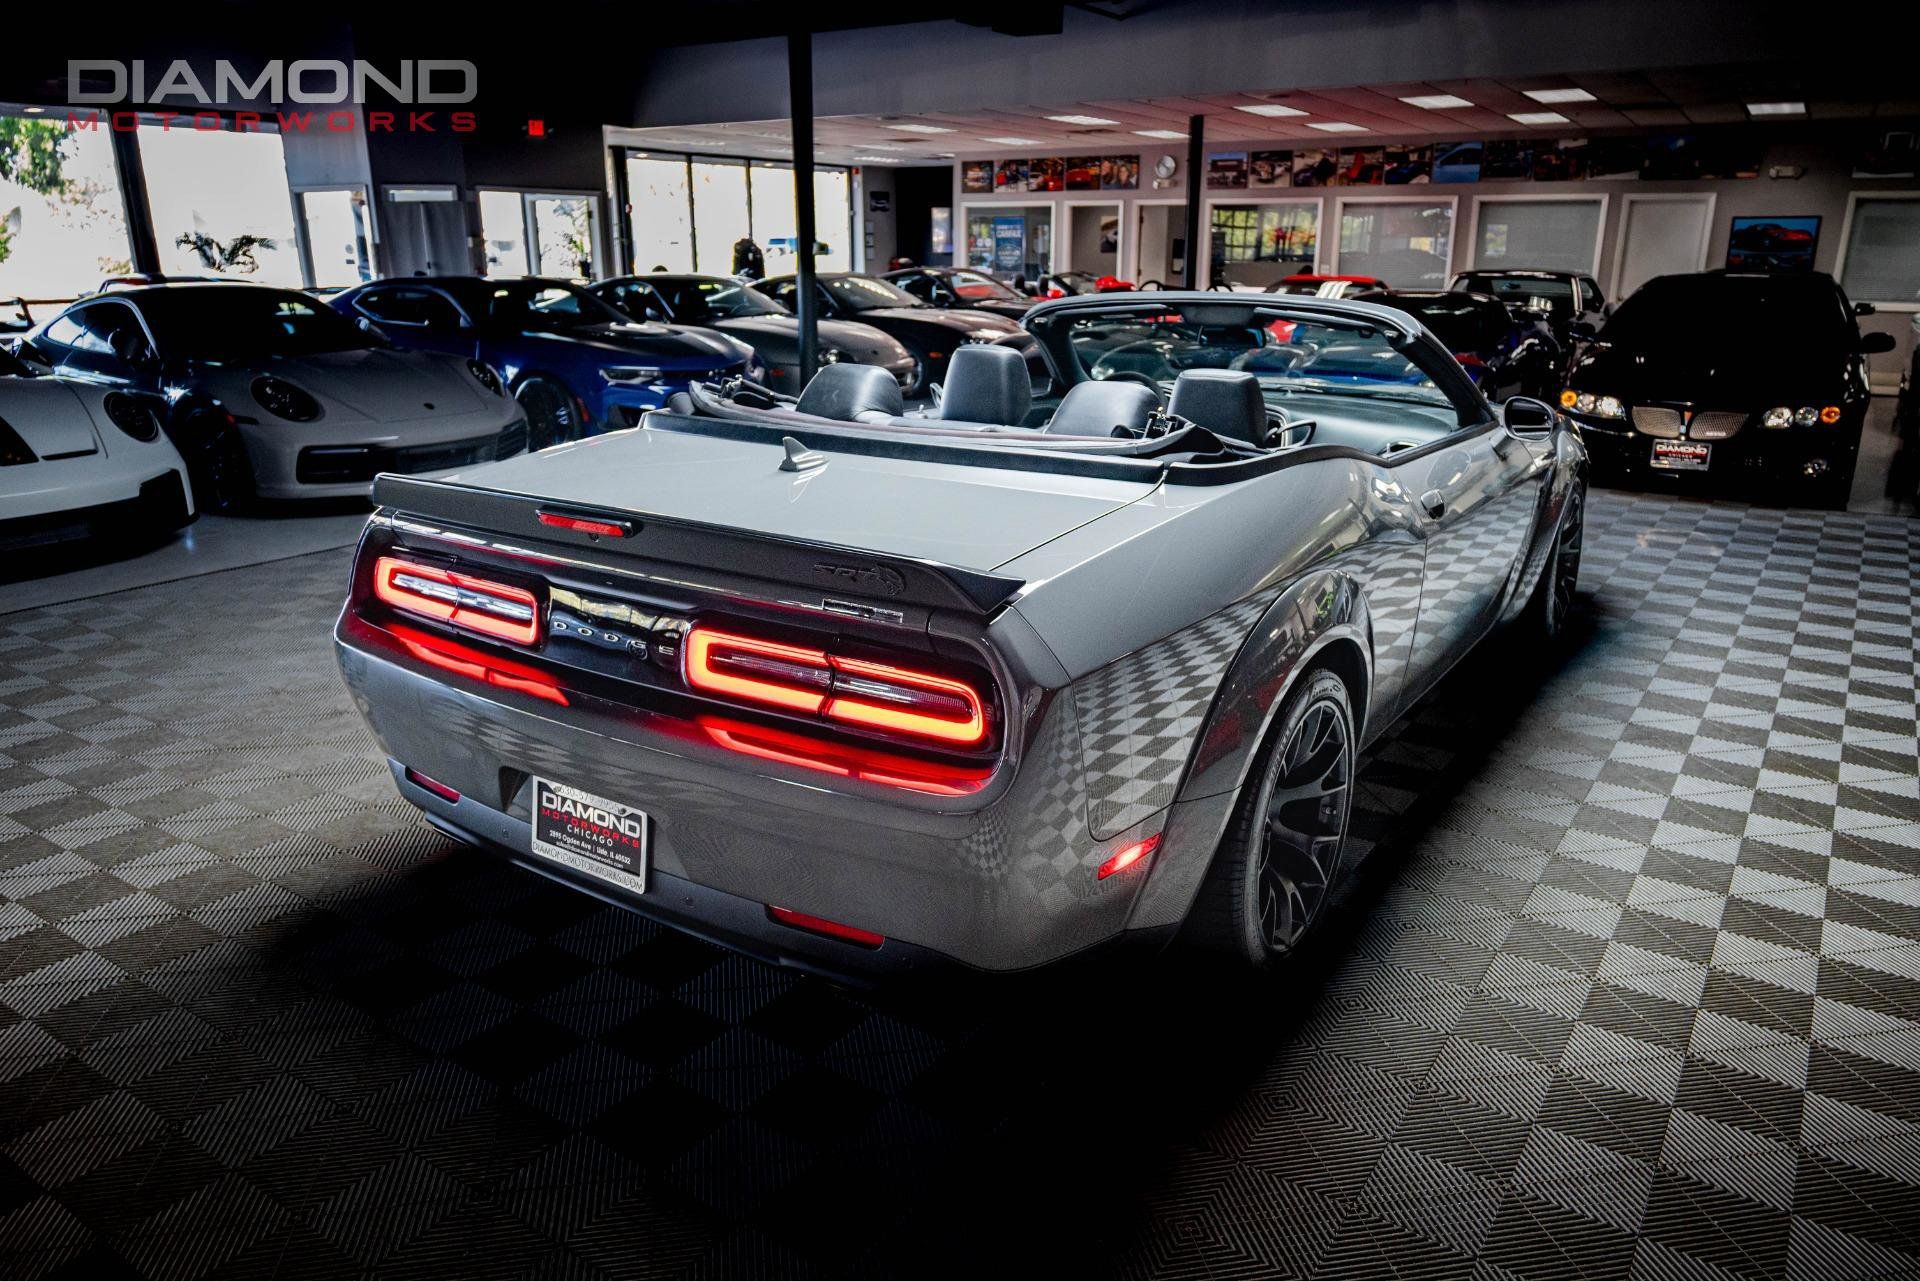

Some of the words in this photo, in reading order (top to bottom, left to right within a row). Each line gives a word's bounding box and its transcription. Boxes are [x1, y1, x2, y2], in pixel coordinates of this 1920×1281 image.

[1656, 445, 1707, 454] DIAMOND
[553, 621, 675, 655] DODGE
[541, 807, 640, 848] MOTORWORKS
[542, 791, 640, 838] DIAMOND
[562, 833, 580, 847] Ogden
[580, 839, 592, 851] Ave
[567, 825, 613, 847] CHICAGO
